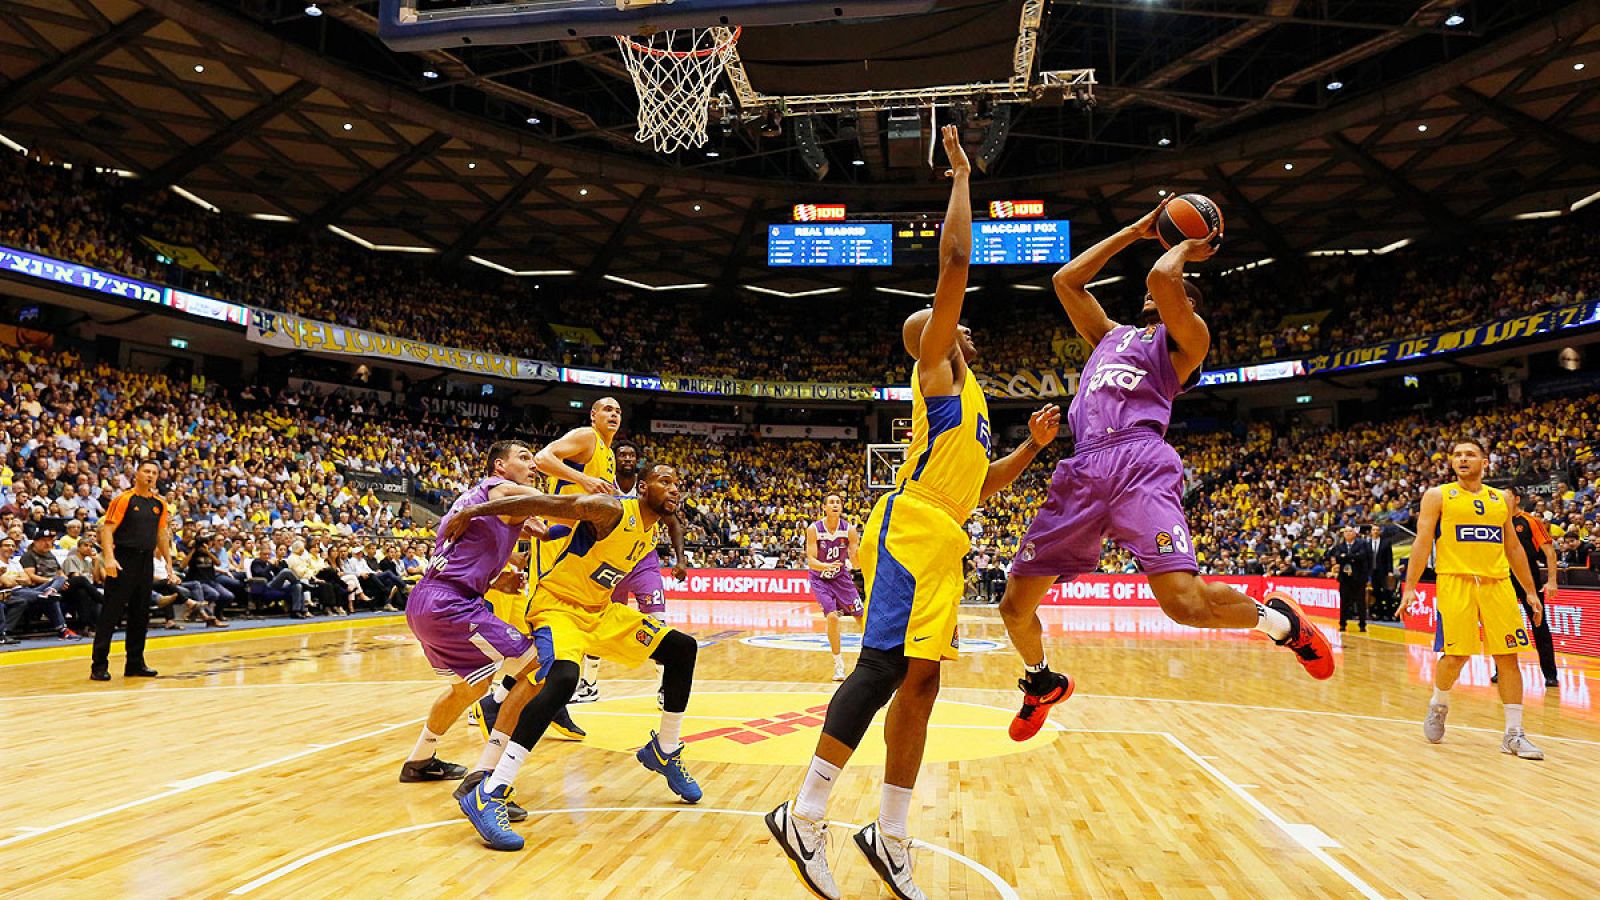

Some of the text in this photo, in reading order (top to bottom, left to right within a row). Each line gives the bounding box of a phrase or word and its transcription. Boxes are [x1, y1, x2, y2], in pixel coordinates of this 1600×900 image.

[794, 227, 866, 237] REAL MADRID
[981, 223, 1057, 234] MACCABI FOX
[1115, 328, 1137, 353] 3
[1395, 336, 1432, 361] OF
[1481, 310, 1551, 346] LIFE
[1559, 307, 1580, 325] 7
[420, 396, 500, 418] SAMSUNG
[1473, 499, 1485, 515] 9
[1172, 524, 1189, 553] 3
[1459, 527, 1501, 541] FOX
[625, 539, 646, 561] 13
[826, 546, 840, 561] 20
[690, 575, 711, 593] OF
[713, 577, 811, 593] HOSPITALITY
[1062, 581, 1110, 600] HOME
[1112, 583, 1141, 600] OF
[1515, 628, 1529, 646] 9
